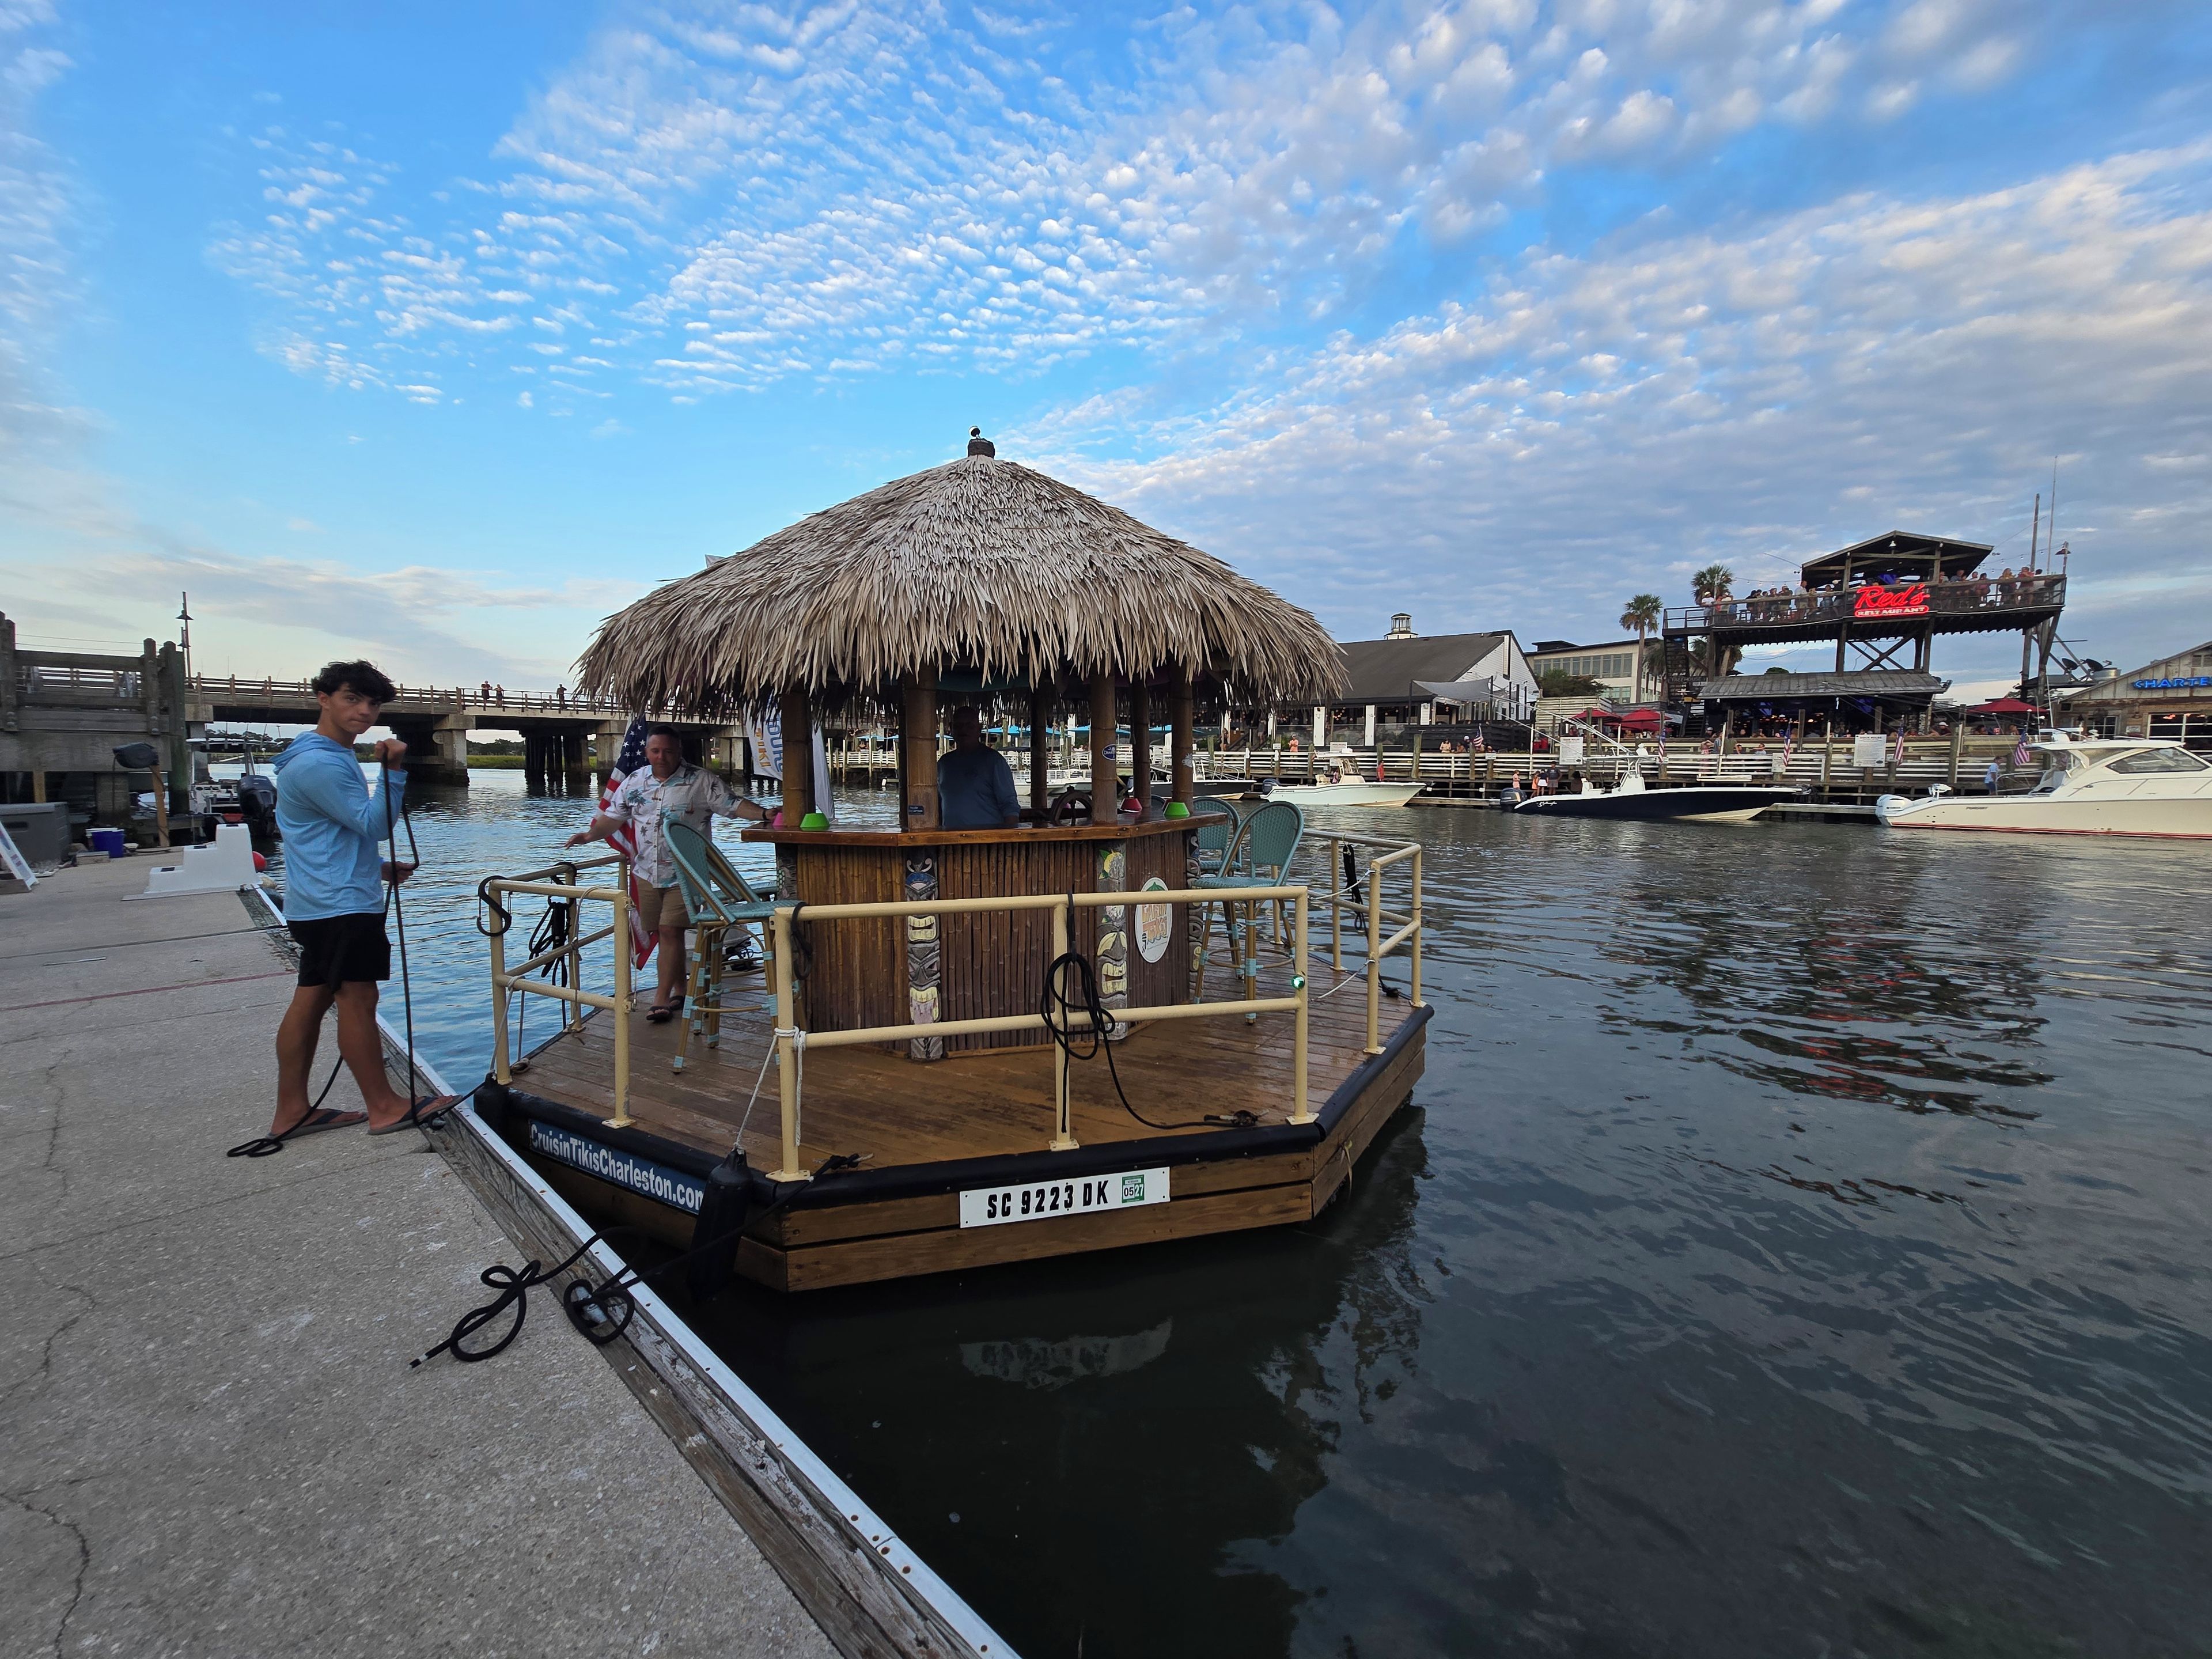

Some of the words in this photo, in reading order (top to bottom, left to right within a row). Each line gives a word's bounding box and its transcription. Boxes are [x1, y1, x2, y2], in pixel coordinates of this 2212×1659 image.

[1854, 583, 1930, 608] Red's
[1857, 607, 1925, 616] RESTAURANT
[987, 1192, 1012, 1219] SC
[1021, 1184, 1074, 1214] 9223
[1082, 1180, 1109, 1206] DK
[1124, 1187, 1134, 1197] 05
[1135, 1184, 1144, 1197] 27
